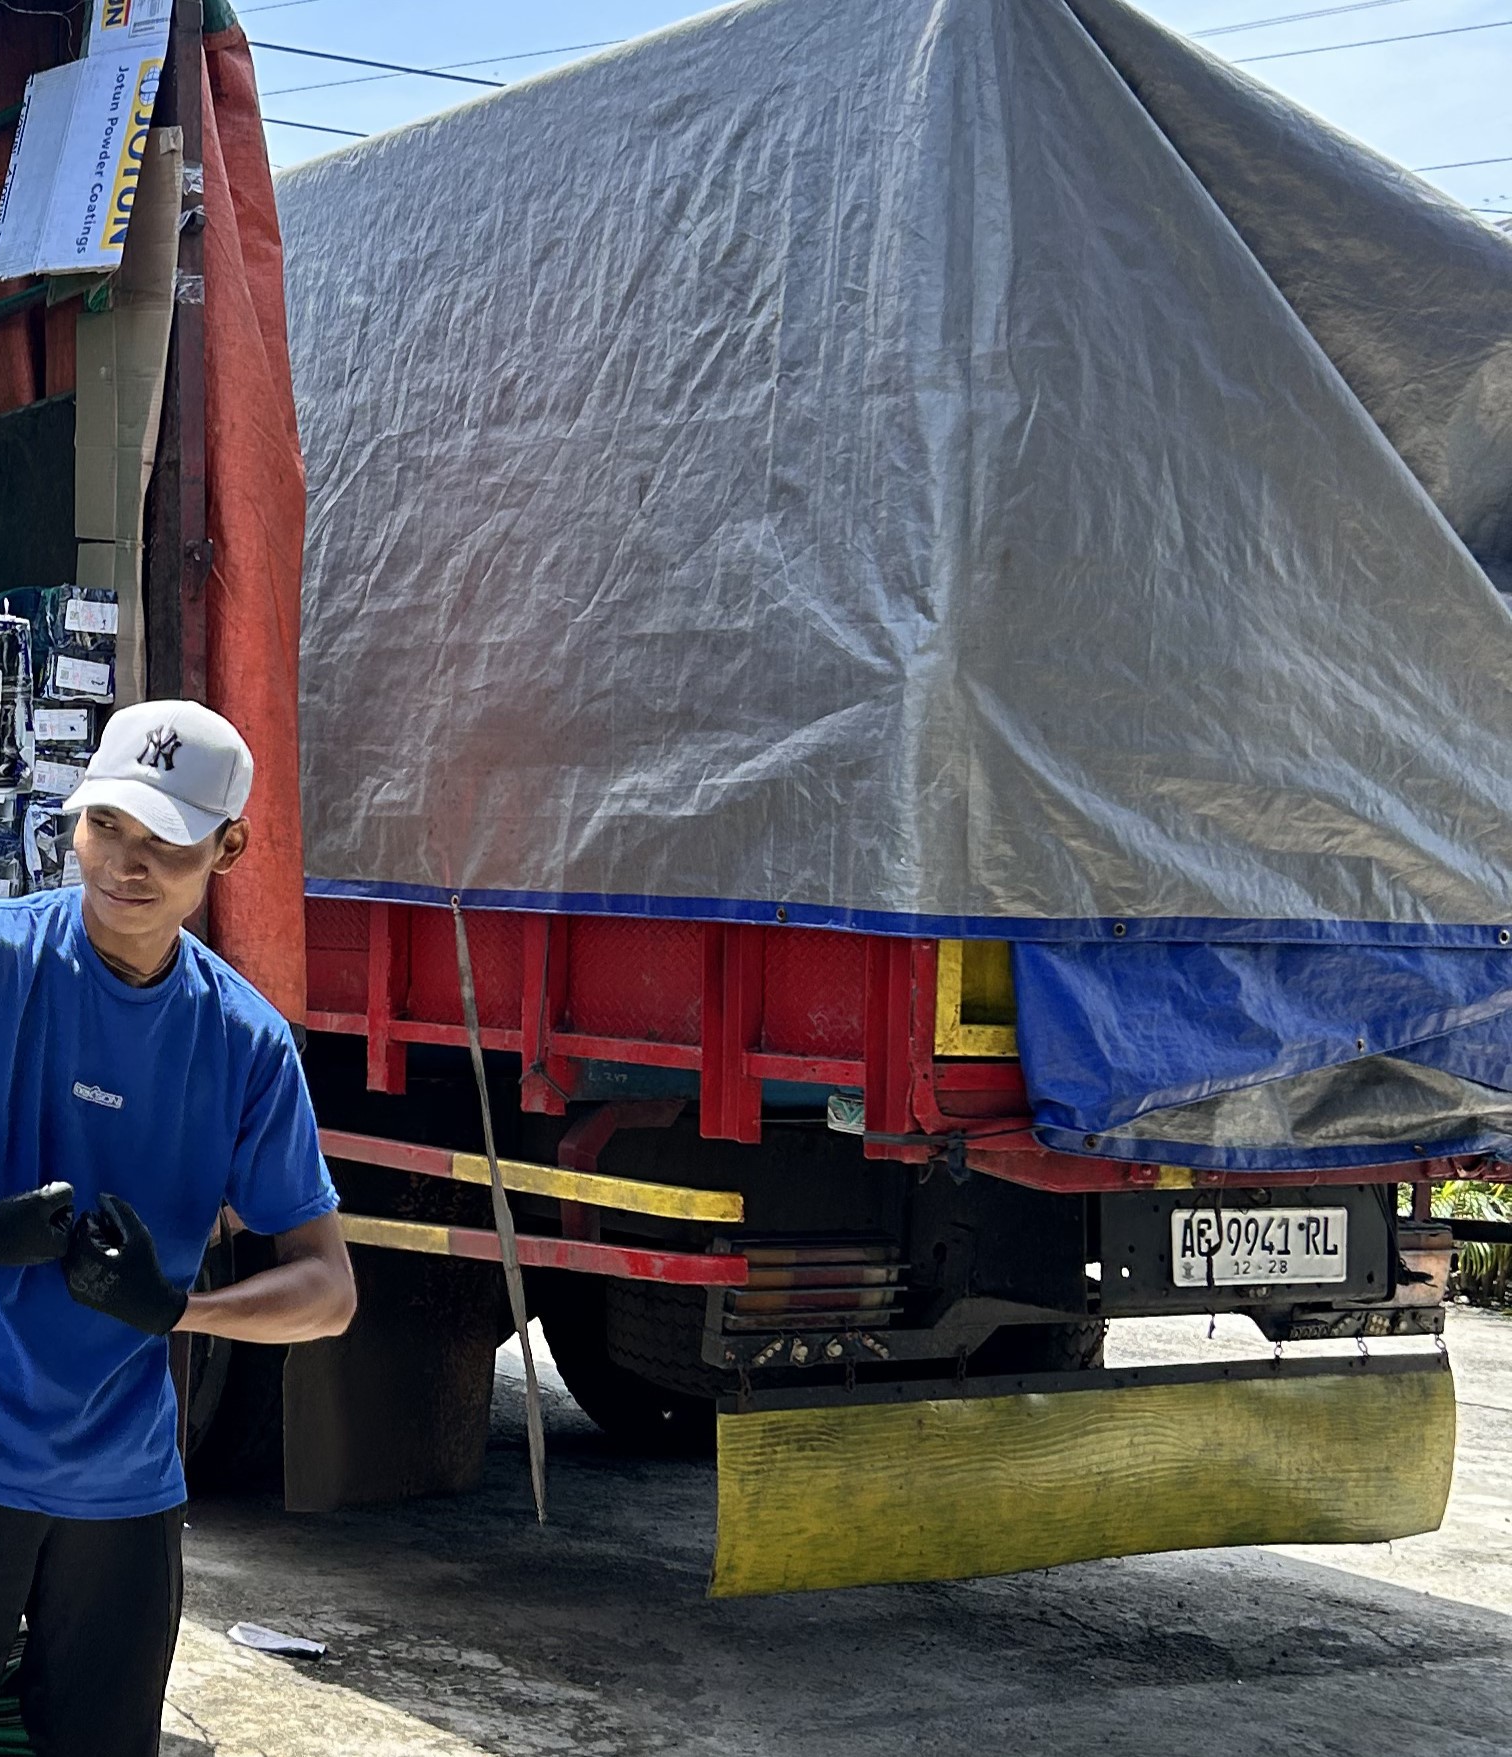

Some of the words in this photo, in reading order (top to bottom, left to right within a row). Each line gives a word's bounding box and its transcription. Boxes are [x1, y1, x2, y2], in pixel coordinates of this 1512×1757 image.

[109, 65, 129, 112] Jotun
[94, 116, 119, 178] Powder
[76, 183, 104, 254] Coatings
[1181, 1217, 1213, 1259] AG
[1227, 1217, 1292, 1257] 9941
[1305, 1216, 1338, 1256] RL
